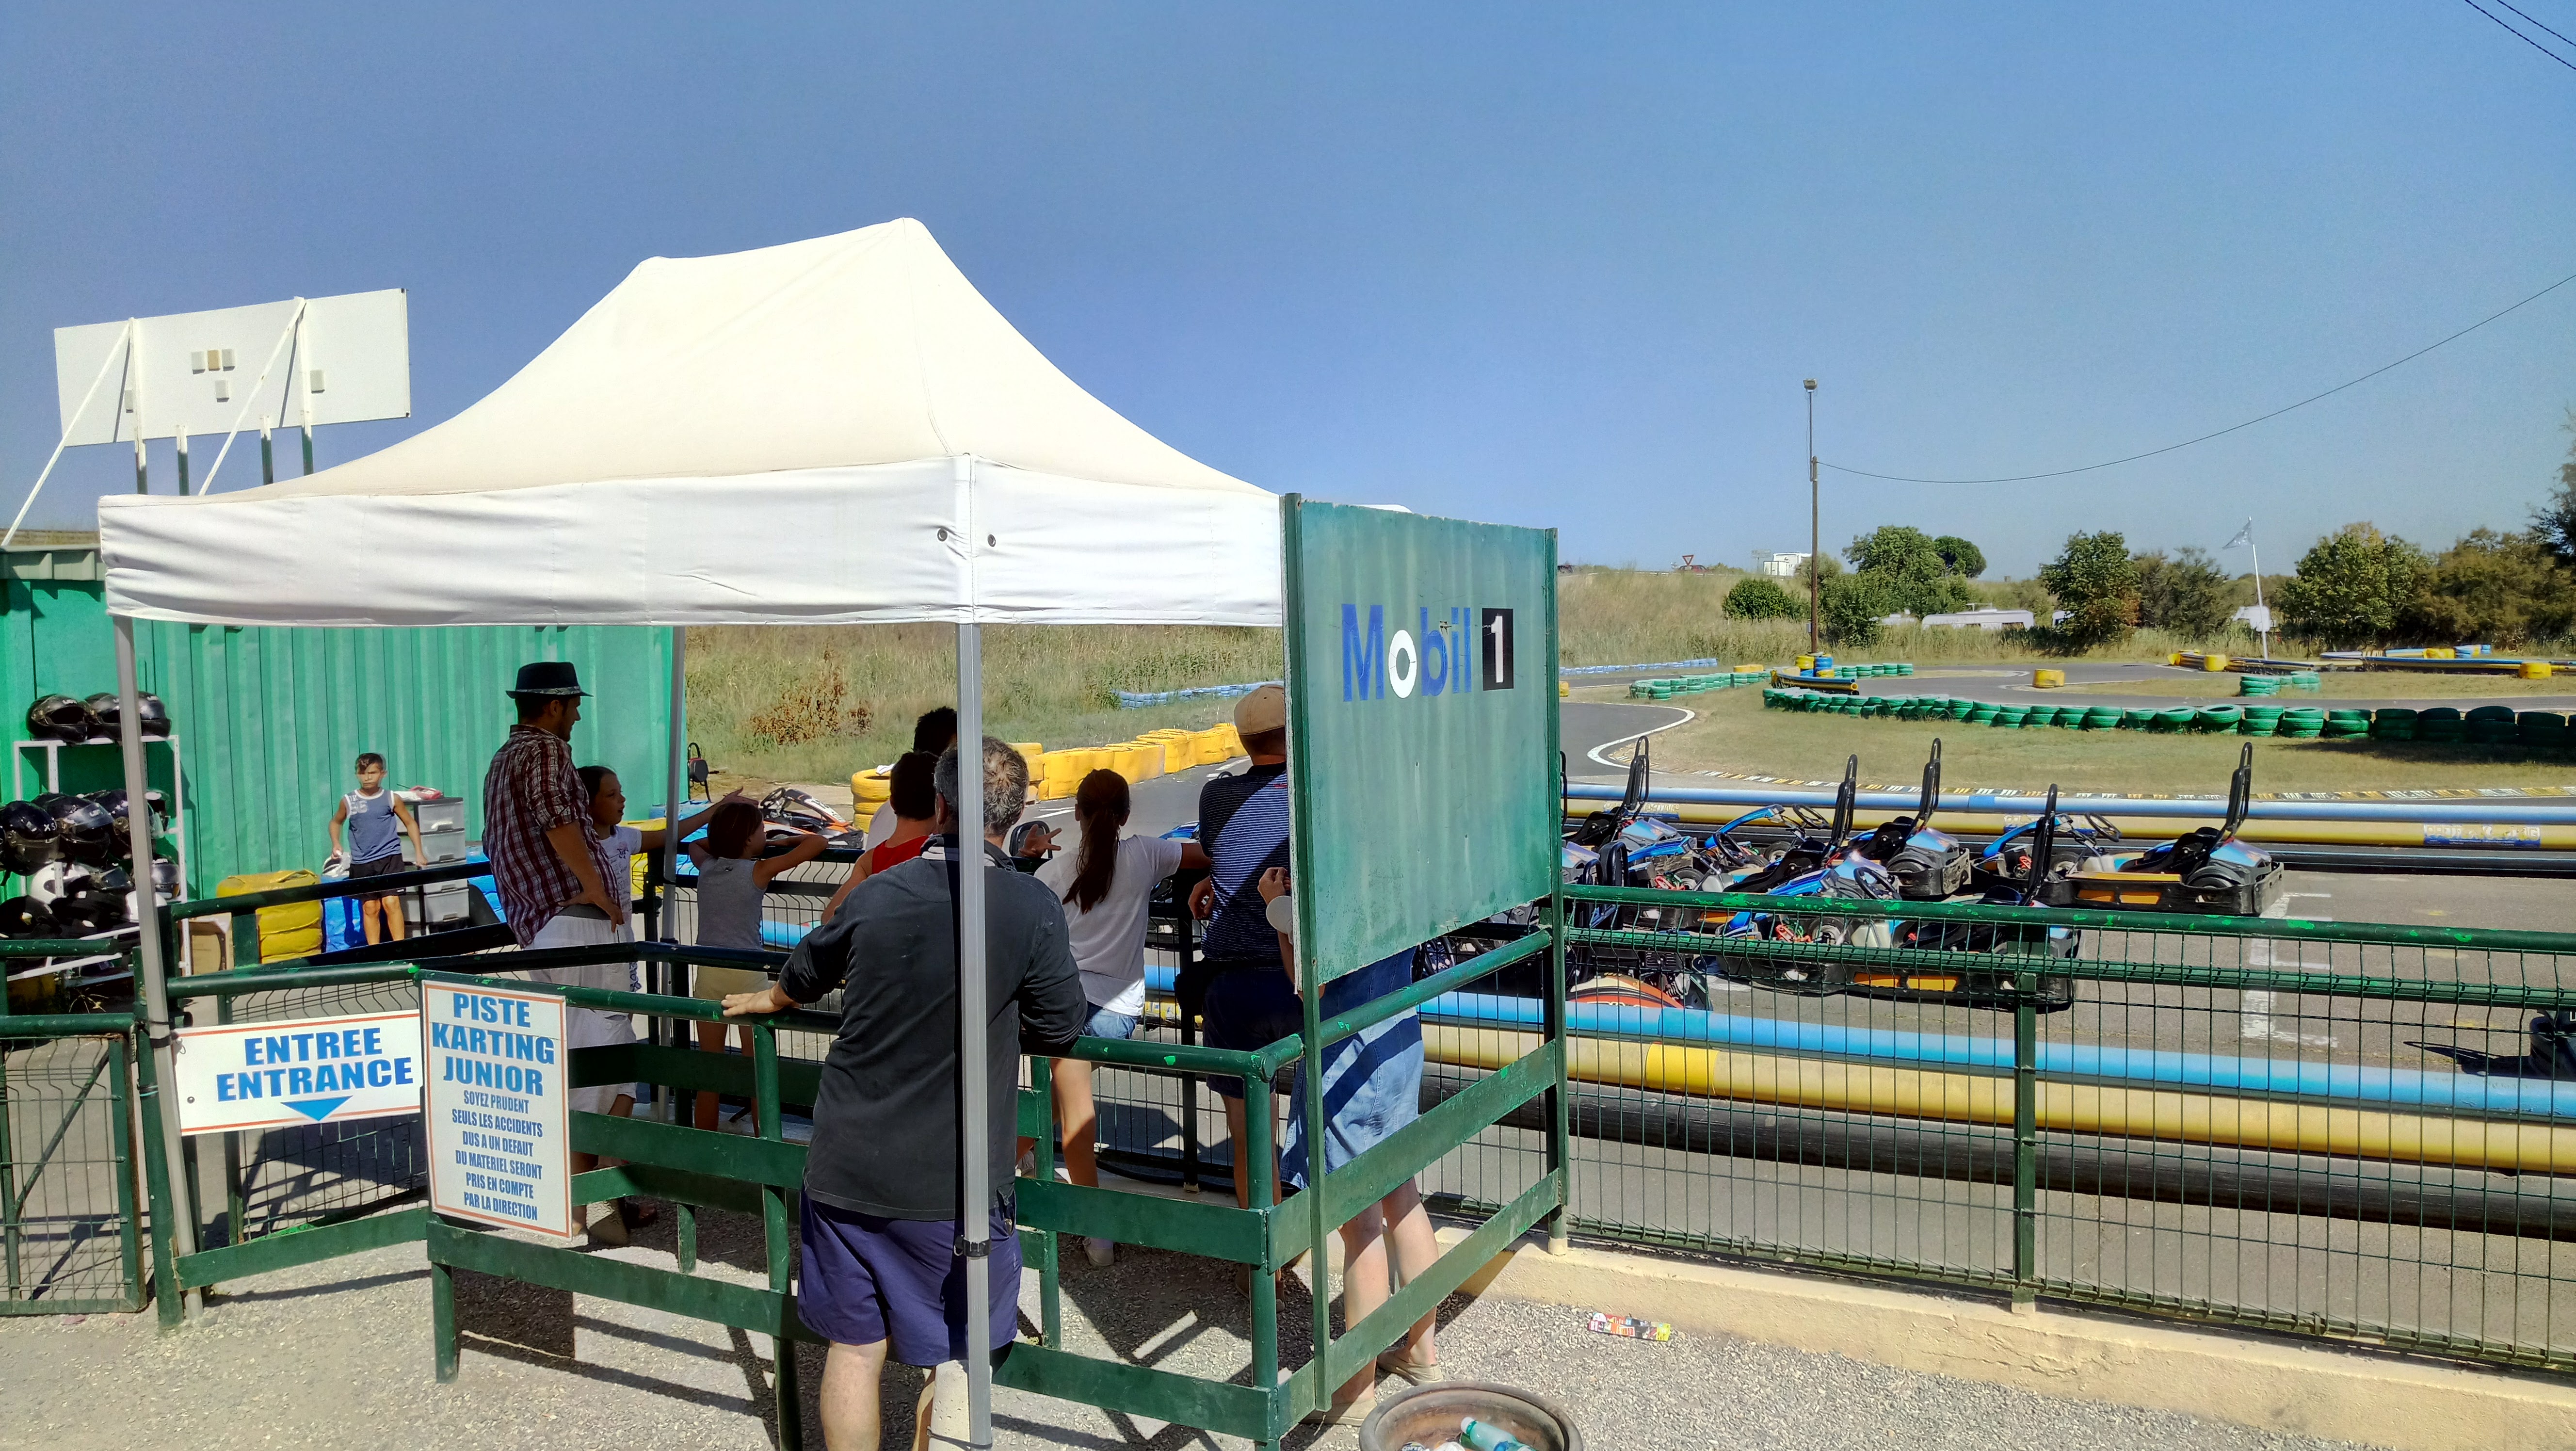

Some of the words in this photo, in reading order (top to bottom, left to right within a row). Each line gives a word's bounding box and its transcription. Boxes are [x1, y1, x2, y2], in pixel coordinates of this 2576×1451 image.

[1341, 603, 1472, 702] Mobil
[453, 992, 531, 1028] PISTE
[245, 1028, 383, 1066] ENTREE
[432, 1022, 554, 1064] KARTING
[217, 1057, 413, 1102] ENTRANCE
[443, 1056, 543, 1096] JUNIOR
[464, 1090, 489, 1108] SOYEZ
[491, 1094, 530, 1114] PRUDENT
[452, 1109, 477, 1126] SEULS
[479, 1113, 493, 1129] LES
[495, 1116, 543, 1138] ACCIDENTS
[463, 1131, 480, 1147] DUS
[482, 1134, 487, 1148] A
[489, 1135, 501, 1151] UN
[502, 1138, 534, 1157] DEFAUT
[455, 1150, 467, 1165] DU
[469, 1152, 508, 1173] MATERIEL
[510, 1160, 543, 1179] SERONT
[466, 1172, 485, 1189] PRIS
[487, 1176, 498, 1192] EN
[499, 1178, 534, 1199] COMPTE
[464, 1192, 480, 1208] PAR
[482, 1195, 492, 1211] LA
[493, 1198, 538, 1221] DIRECTION
